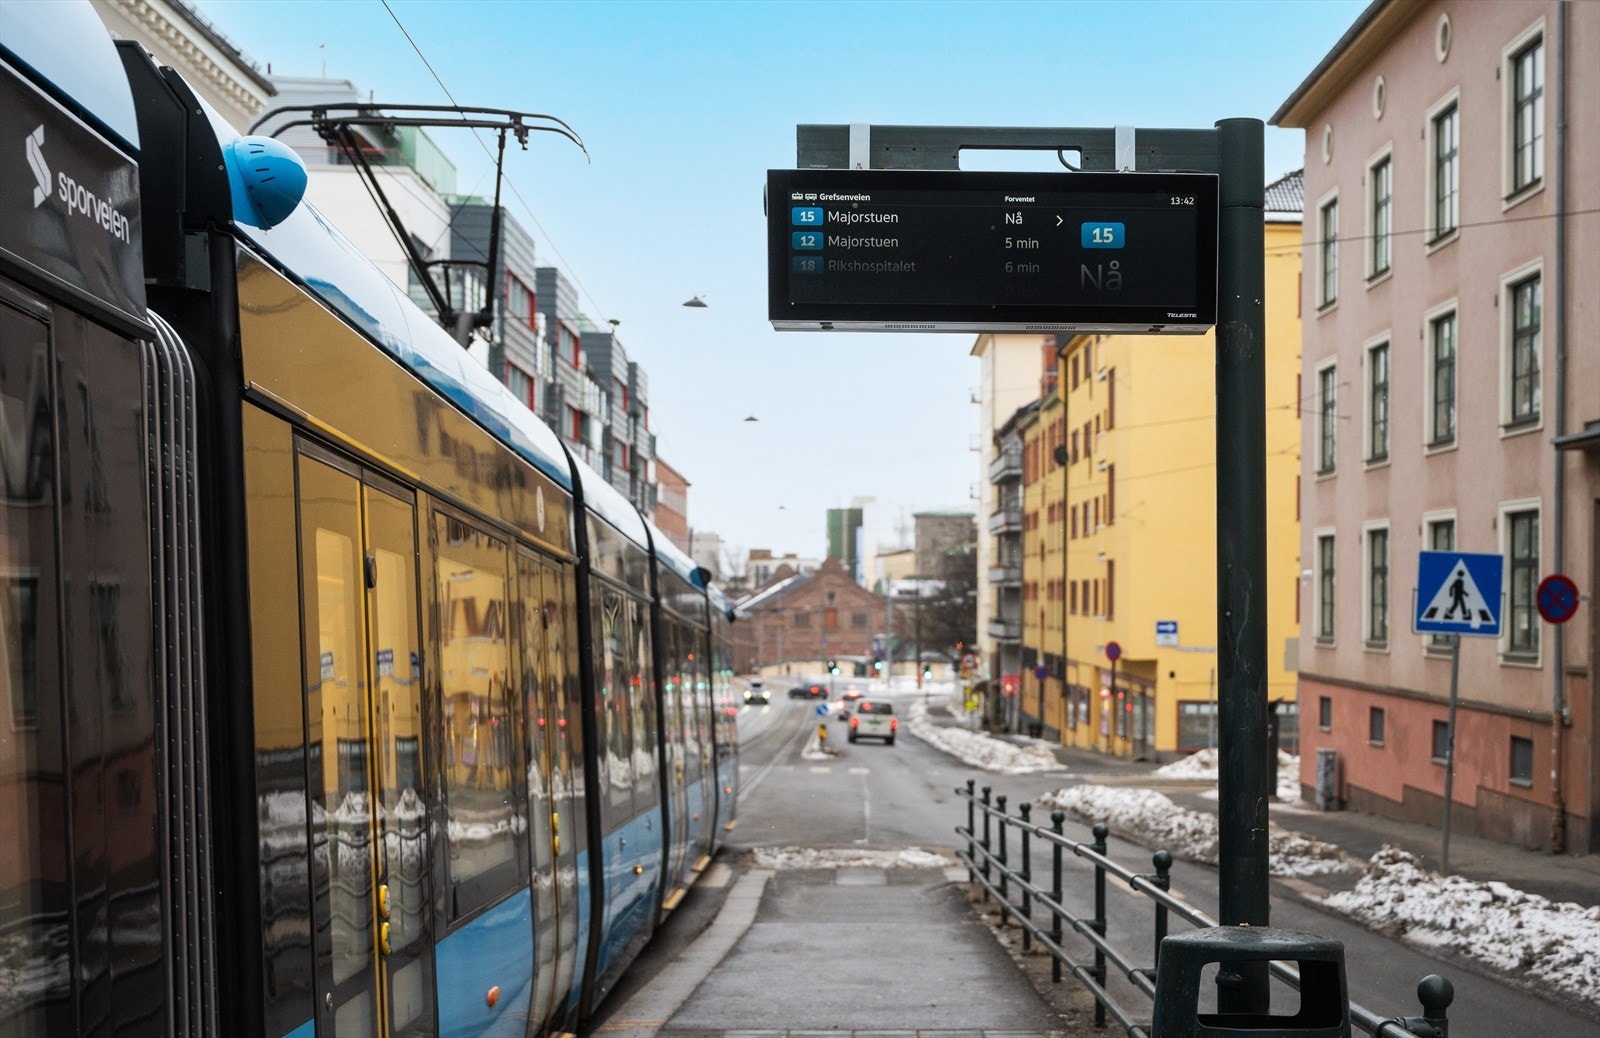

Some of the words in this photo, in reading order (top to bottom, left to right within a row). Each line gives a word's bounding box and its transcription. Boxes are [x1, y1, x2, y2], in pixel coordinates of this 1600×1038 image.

[819, 193, 871, 202] Grefsenveien
[1004, 195, 1036, 203] Forventet
[1170, 196, 1195, 206] 13:42
[58, 171, 130, 245] sporveien
[800, 211, 815, 222] 15
[828, 211, 899, 225] Majorstuen
[1005, 211, 1023, 225] Nå
[800, 236, 815, 247] 12
[828, 235, 899, 250] Majorstuen
[1004, 237, 1013, 249] 5
[1016, 237, 1040, 249] min
[1092, 227, 1114, 244] 15
[800, 260, 816, 272] 18
[828, 259, 916, 274] Rikshospitalet
[1005, 261, 1014, 273] 6
[1017, 261, 1040, 273] min
[1080, 260, 1123, 291] Nå
